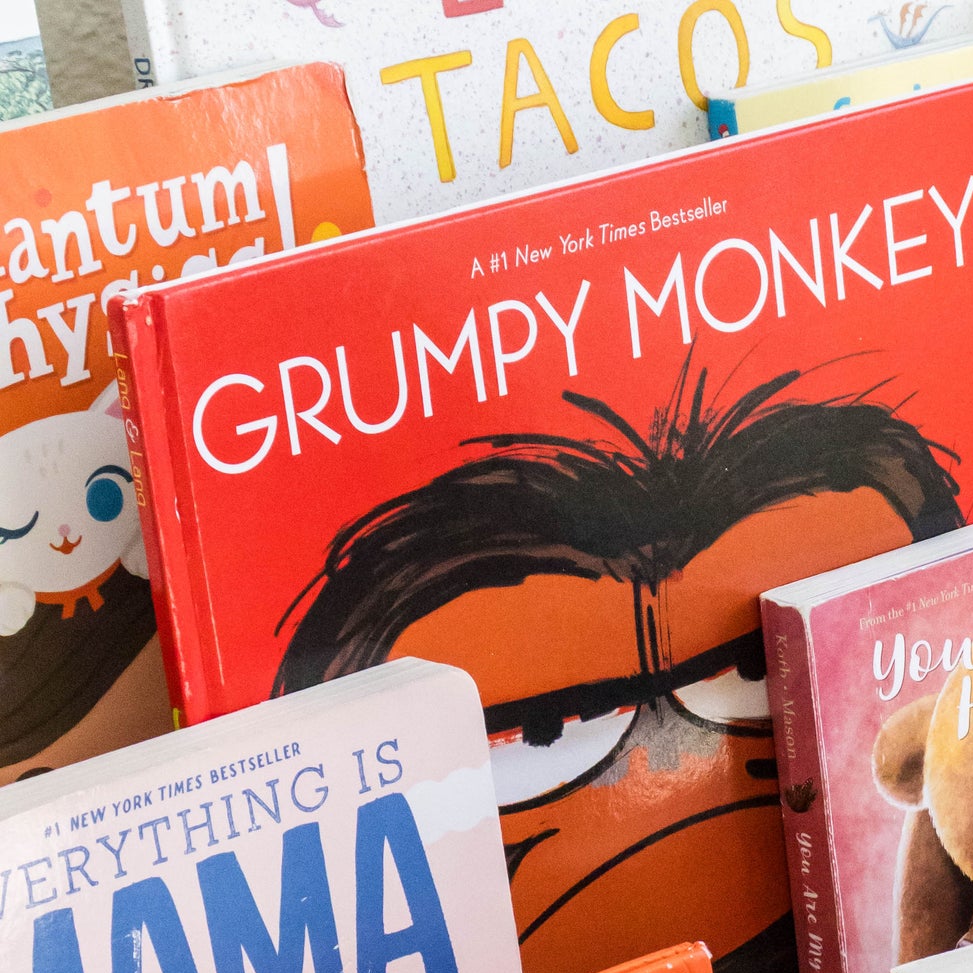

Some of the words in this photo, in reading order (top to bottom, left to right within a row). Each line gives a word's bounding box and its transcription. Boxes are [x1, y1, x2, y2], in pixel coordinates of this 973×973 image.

[0, 143, 296, 284] antum!
[471, 257, 485, 279] A
[489, 251, 508, 274] #1
[515, 244, 553, 268] New
[559, 228, 594, 255] York
[598, 220, 646, 245] Times
[650, 195, 728, 232] Bestseller
[192, 279, 591, 476] GRUMPY
[859, 613, 886, 631] From
[888, 606, 904, 620] the
[906, 601, 917, 613] #1
[919, 595, 939, 610] New
[940, 585, 960, 602] York
[44, 821, 61, 839] #1
[70, 805, 107, 832] NEW
[112, 790, 153, 818] YORK
[158, 774, 202, 802] TIMES
[210, 741, 301, 784] BESTSELLER
[353, 738, 405, 795] IS
